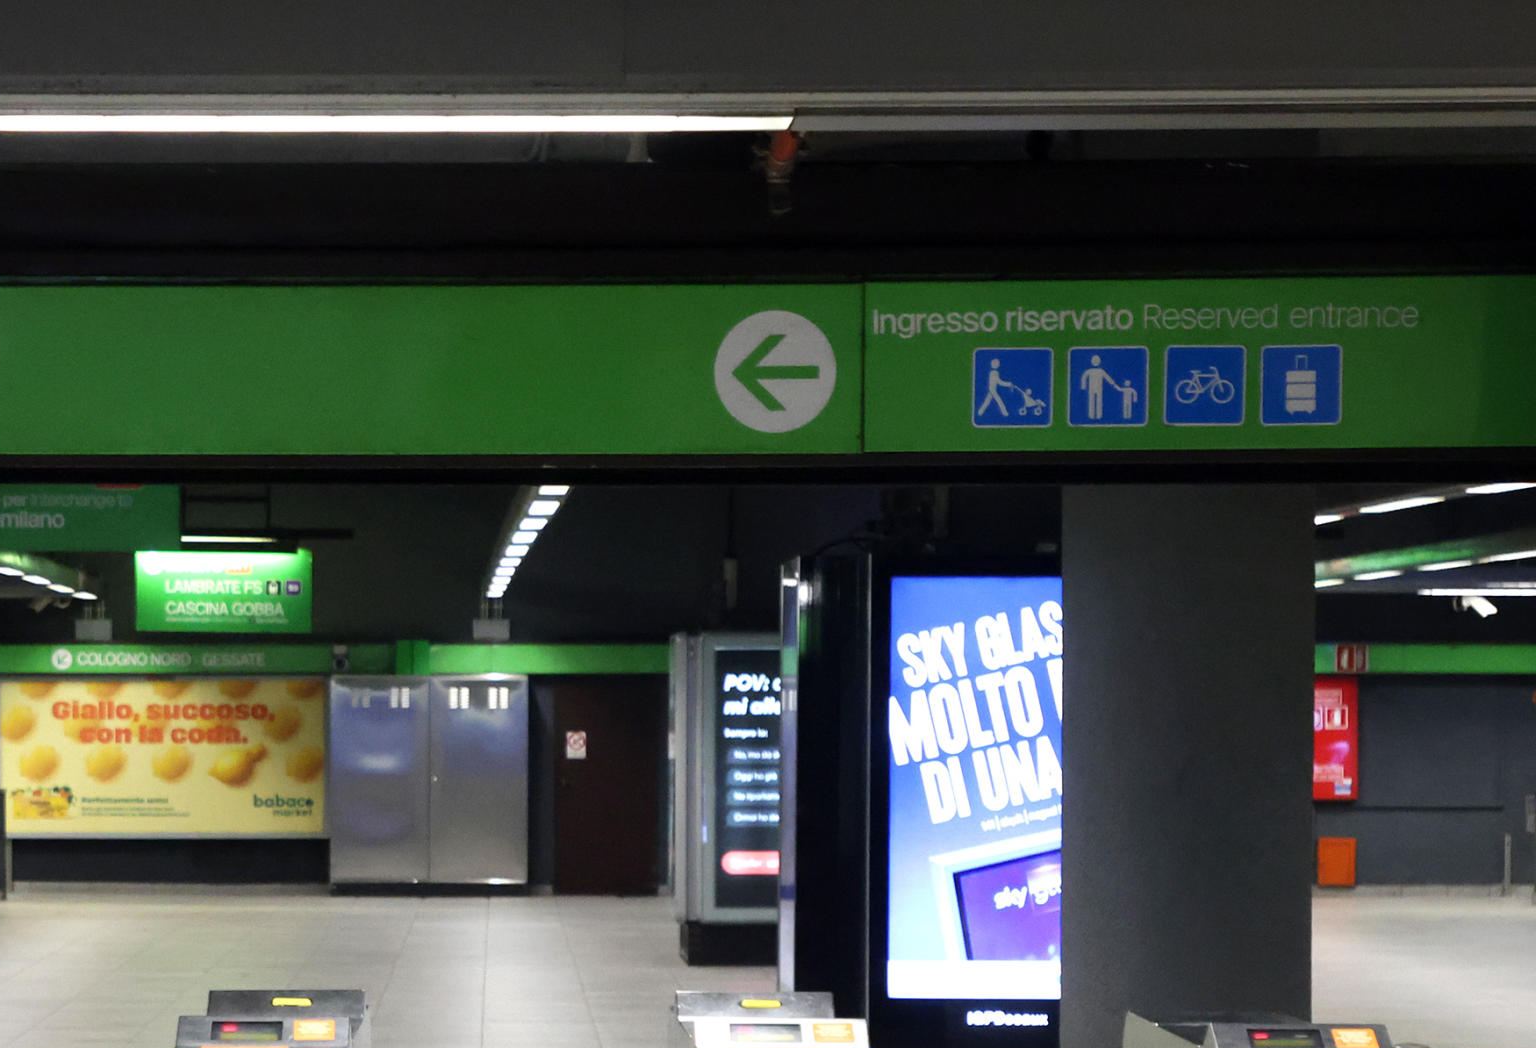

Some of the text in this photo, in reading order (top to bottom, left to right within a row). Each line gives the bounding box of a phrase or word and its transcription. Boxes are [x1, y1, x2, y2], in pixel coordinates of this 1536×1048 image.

[873, 304, 1419, 338] Ingresso riservato Reserved entrance
[166, 580, 263, 594] LAMBRATE FS
[166, 602, 285, 616] CASCINA GOBBA
[77, 653, 264, 668] COLOGNO NORD GESSATE
[897, 621, 968, 687] SKY
[723, 673, 770, 692] POV:
[52, 701, 275, 722] Giallo, succoso,
[889, 666, 1044, 766] MOLTO
[79, 725, 248, 744] con la coda.
[919, 735, 1063, 824] DI UNA
